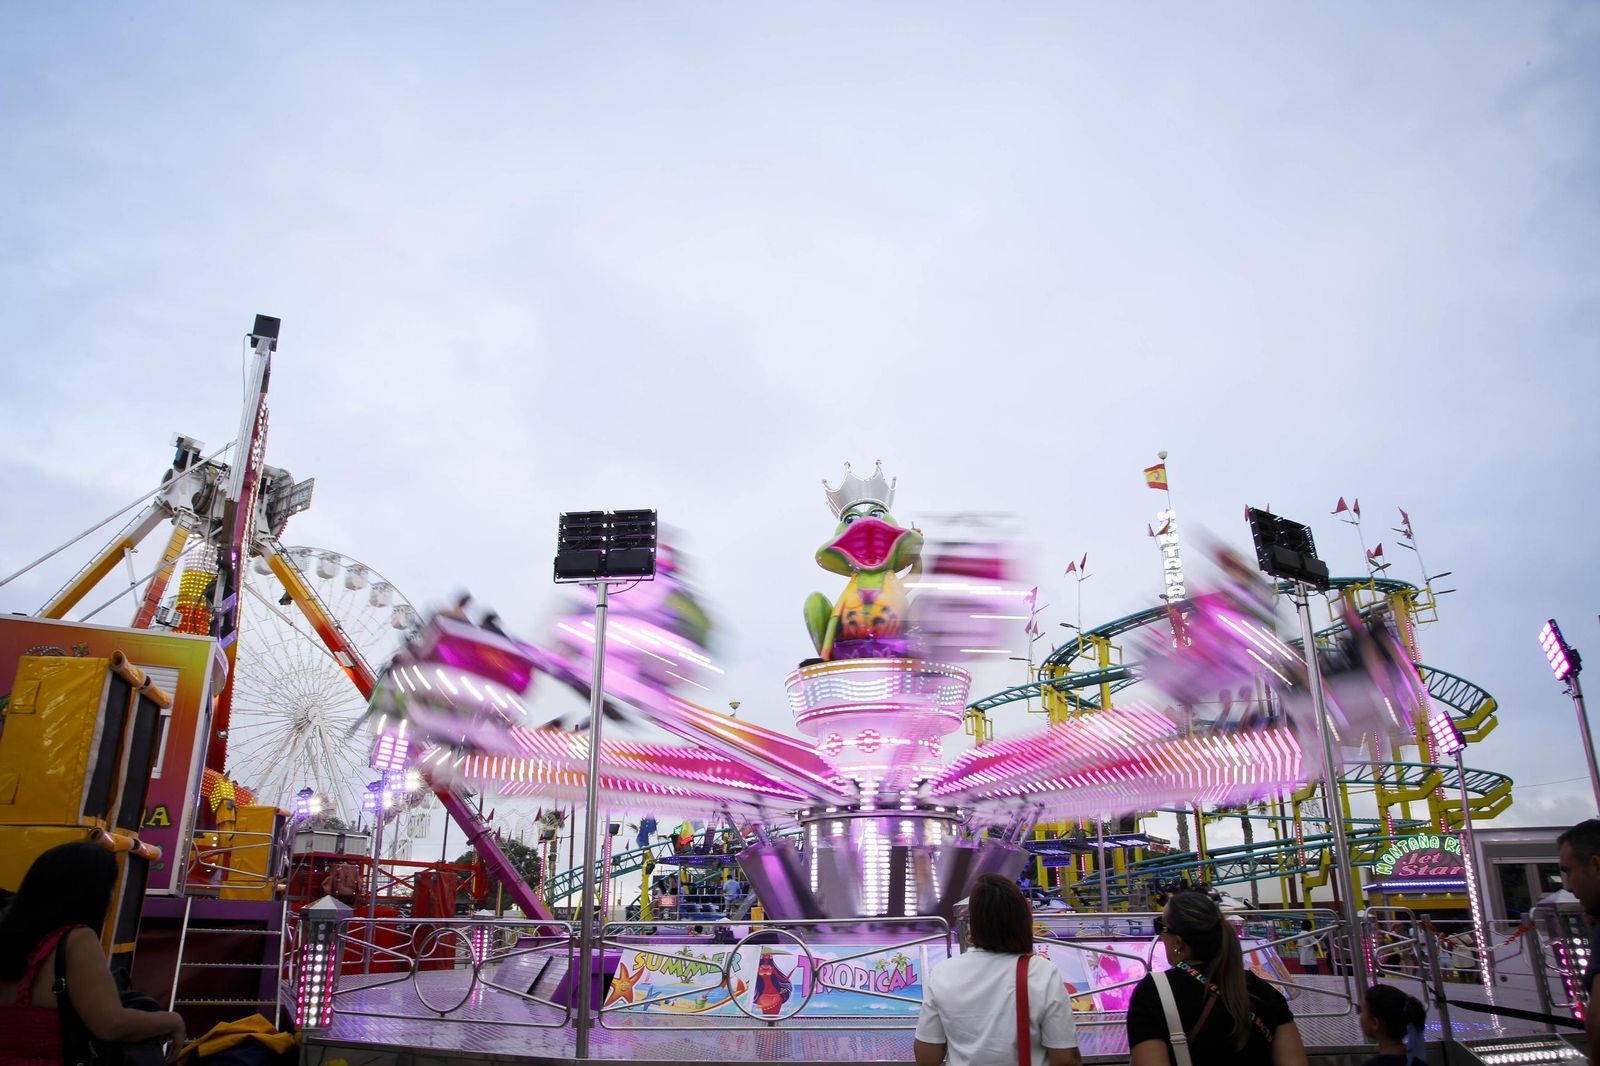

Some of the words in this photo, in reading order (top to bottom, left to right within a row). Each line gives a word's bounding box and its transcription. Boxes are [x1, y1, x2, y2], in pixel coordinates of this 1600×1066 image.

[1376, 833, 1440, 875] MONTAÑA
[1398, 863, 1465, 877] Star
[632, 951, 742, 977] SUMMER
[797, 954, 918, 998] TROPICAL
[1176, 961, 1199, 977] LOVE
